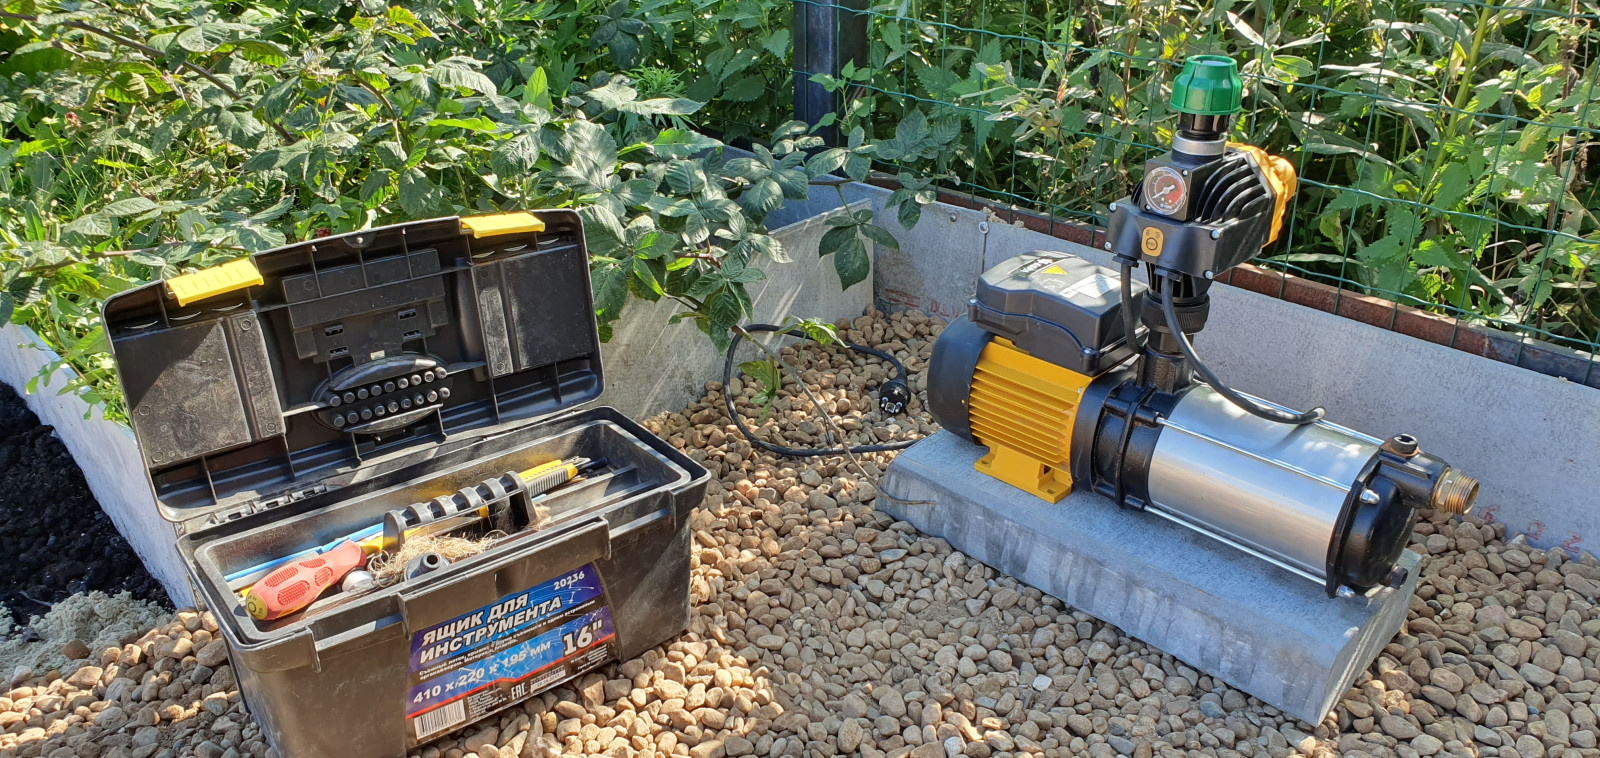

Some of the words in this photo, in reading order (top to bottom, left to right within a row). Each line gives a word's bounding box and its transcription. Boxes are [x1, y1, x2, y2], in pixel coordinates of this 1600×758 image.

[553, 570, 585, 591] 20236
[419, 596, 562, 664] ИНСТРУМЕНТА
[421, 611, 483, 647] ЯЩИК
[487, 593, 529, 622] ДЛЯ
[413, 685, 442, 704] 410
[458, 668, 485, 687] 220
[503, 652, 528, 668] 195
